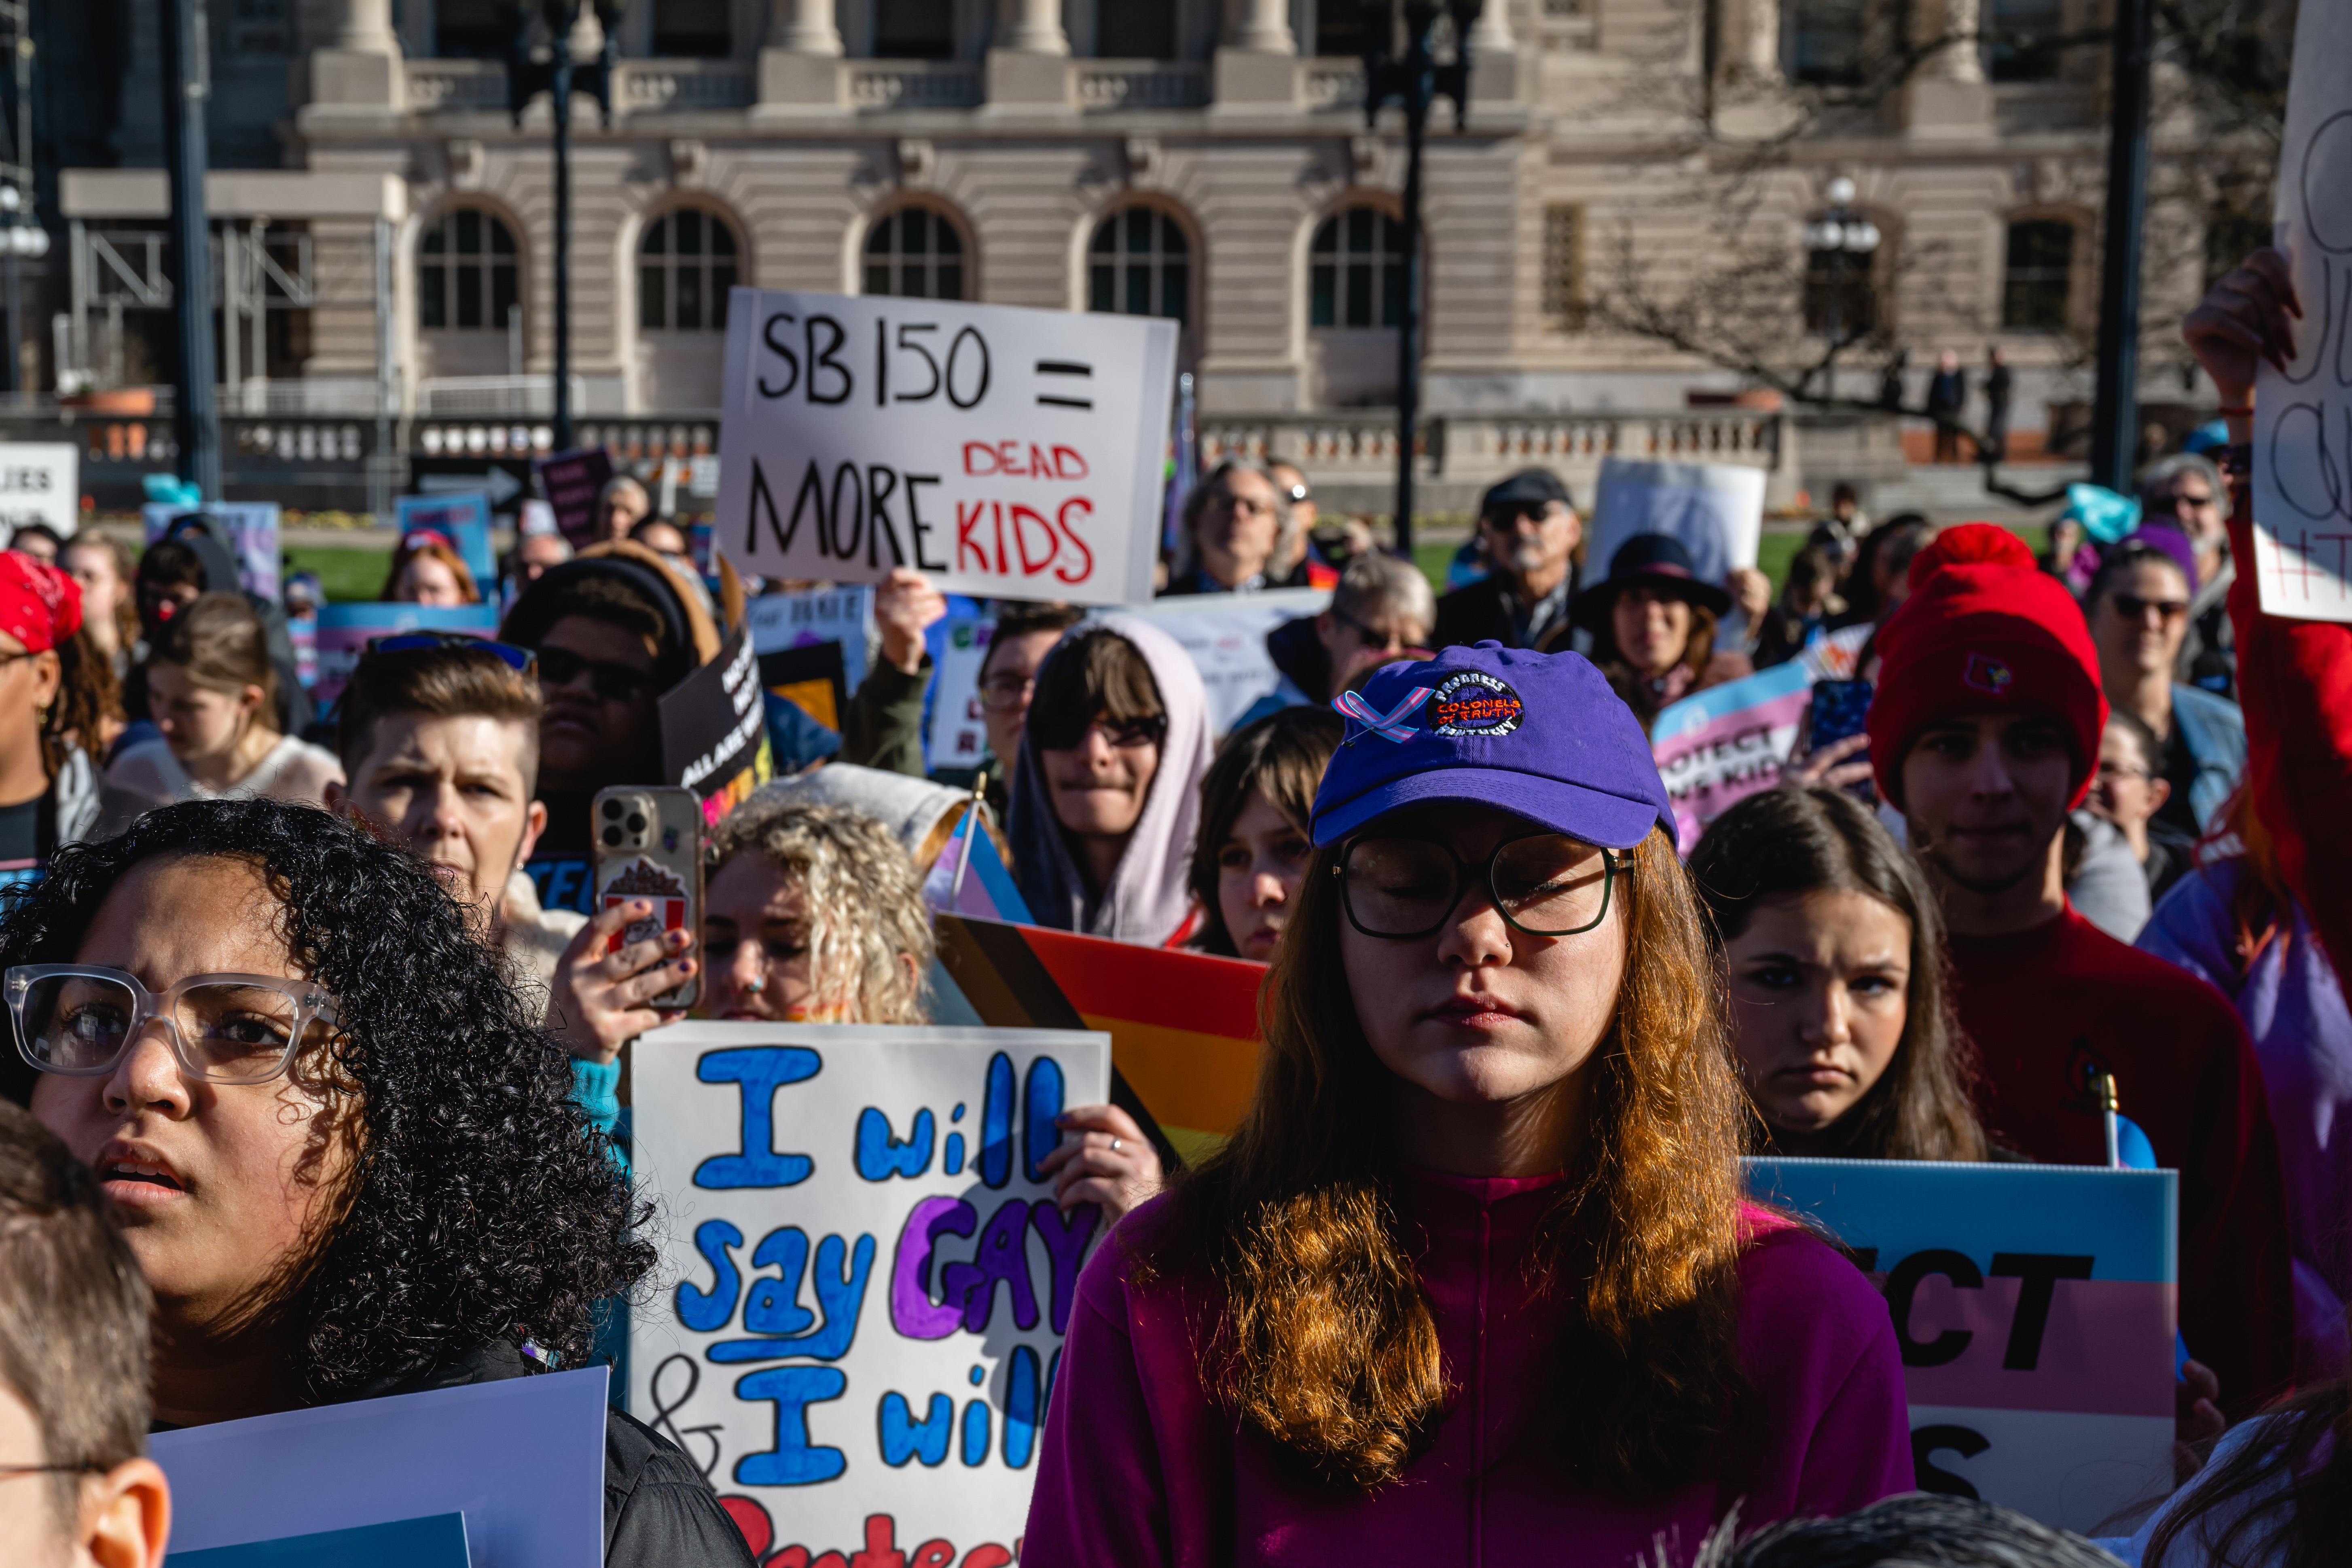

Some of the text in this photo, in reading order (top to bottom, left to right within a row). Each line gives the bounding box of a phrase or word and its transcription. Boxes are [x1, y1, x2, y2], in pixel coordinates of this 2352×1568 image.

[758, 312, 854, 406] SB
[876, 317, 991, 410] 150
[963, 440, 1089, 481] DEAD
[746, 456, 1095, 586] MORE KIDS
[1434, 716, 1516, 736] KENTUCKY
[1437, 699, 1521, 713] COLONELS
[1459, 707, 1516, 721] TRUTH
[1658, 722, 1774, 774] OTECT
[692, 1045, 1065, 1190] I will
[889, 1194, 1103, 1339] GAY
[1855, 1248, 2095, 1371] CT
[734, 1365, 847, 1487] I
[877, 1345, 1063, 1470] wil
